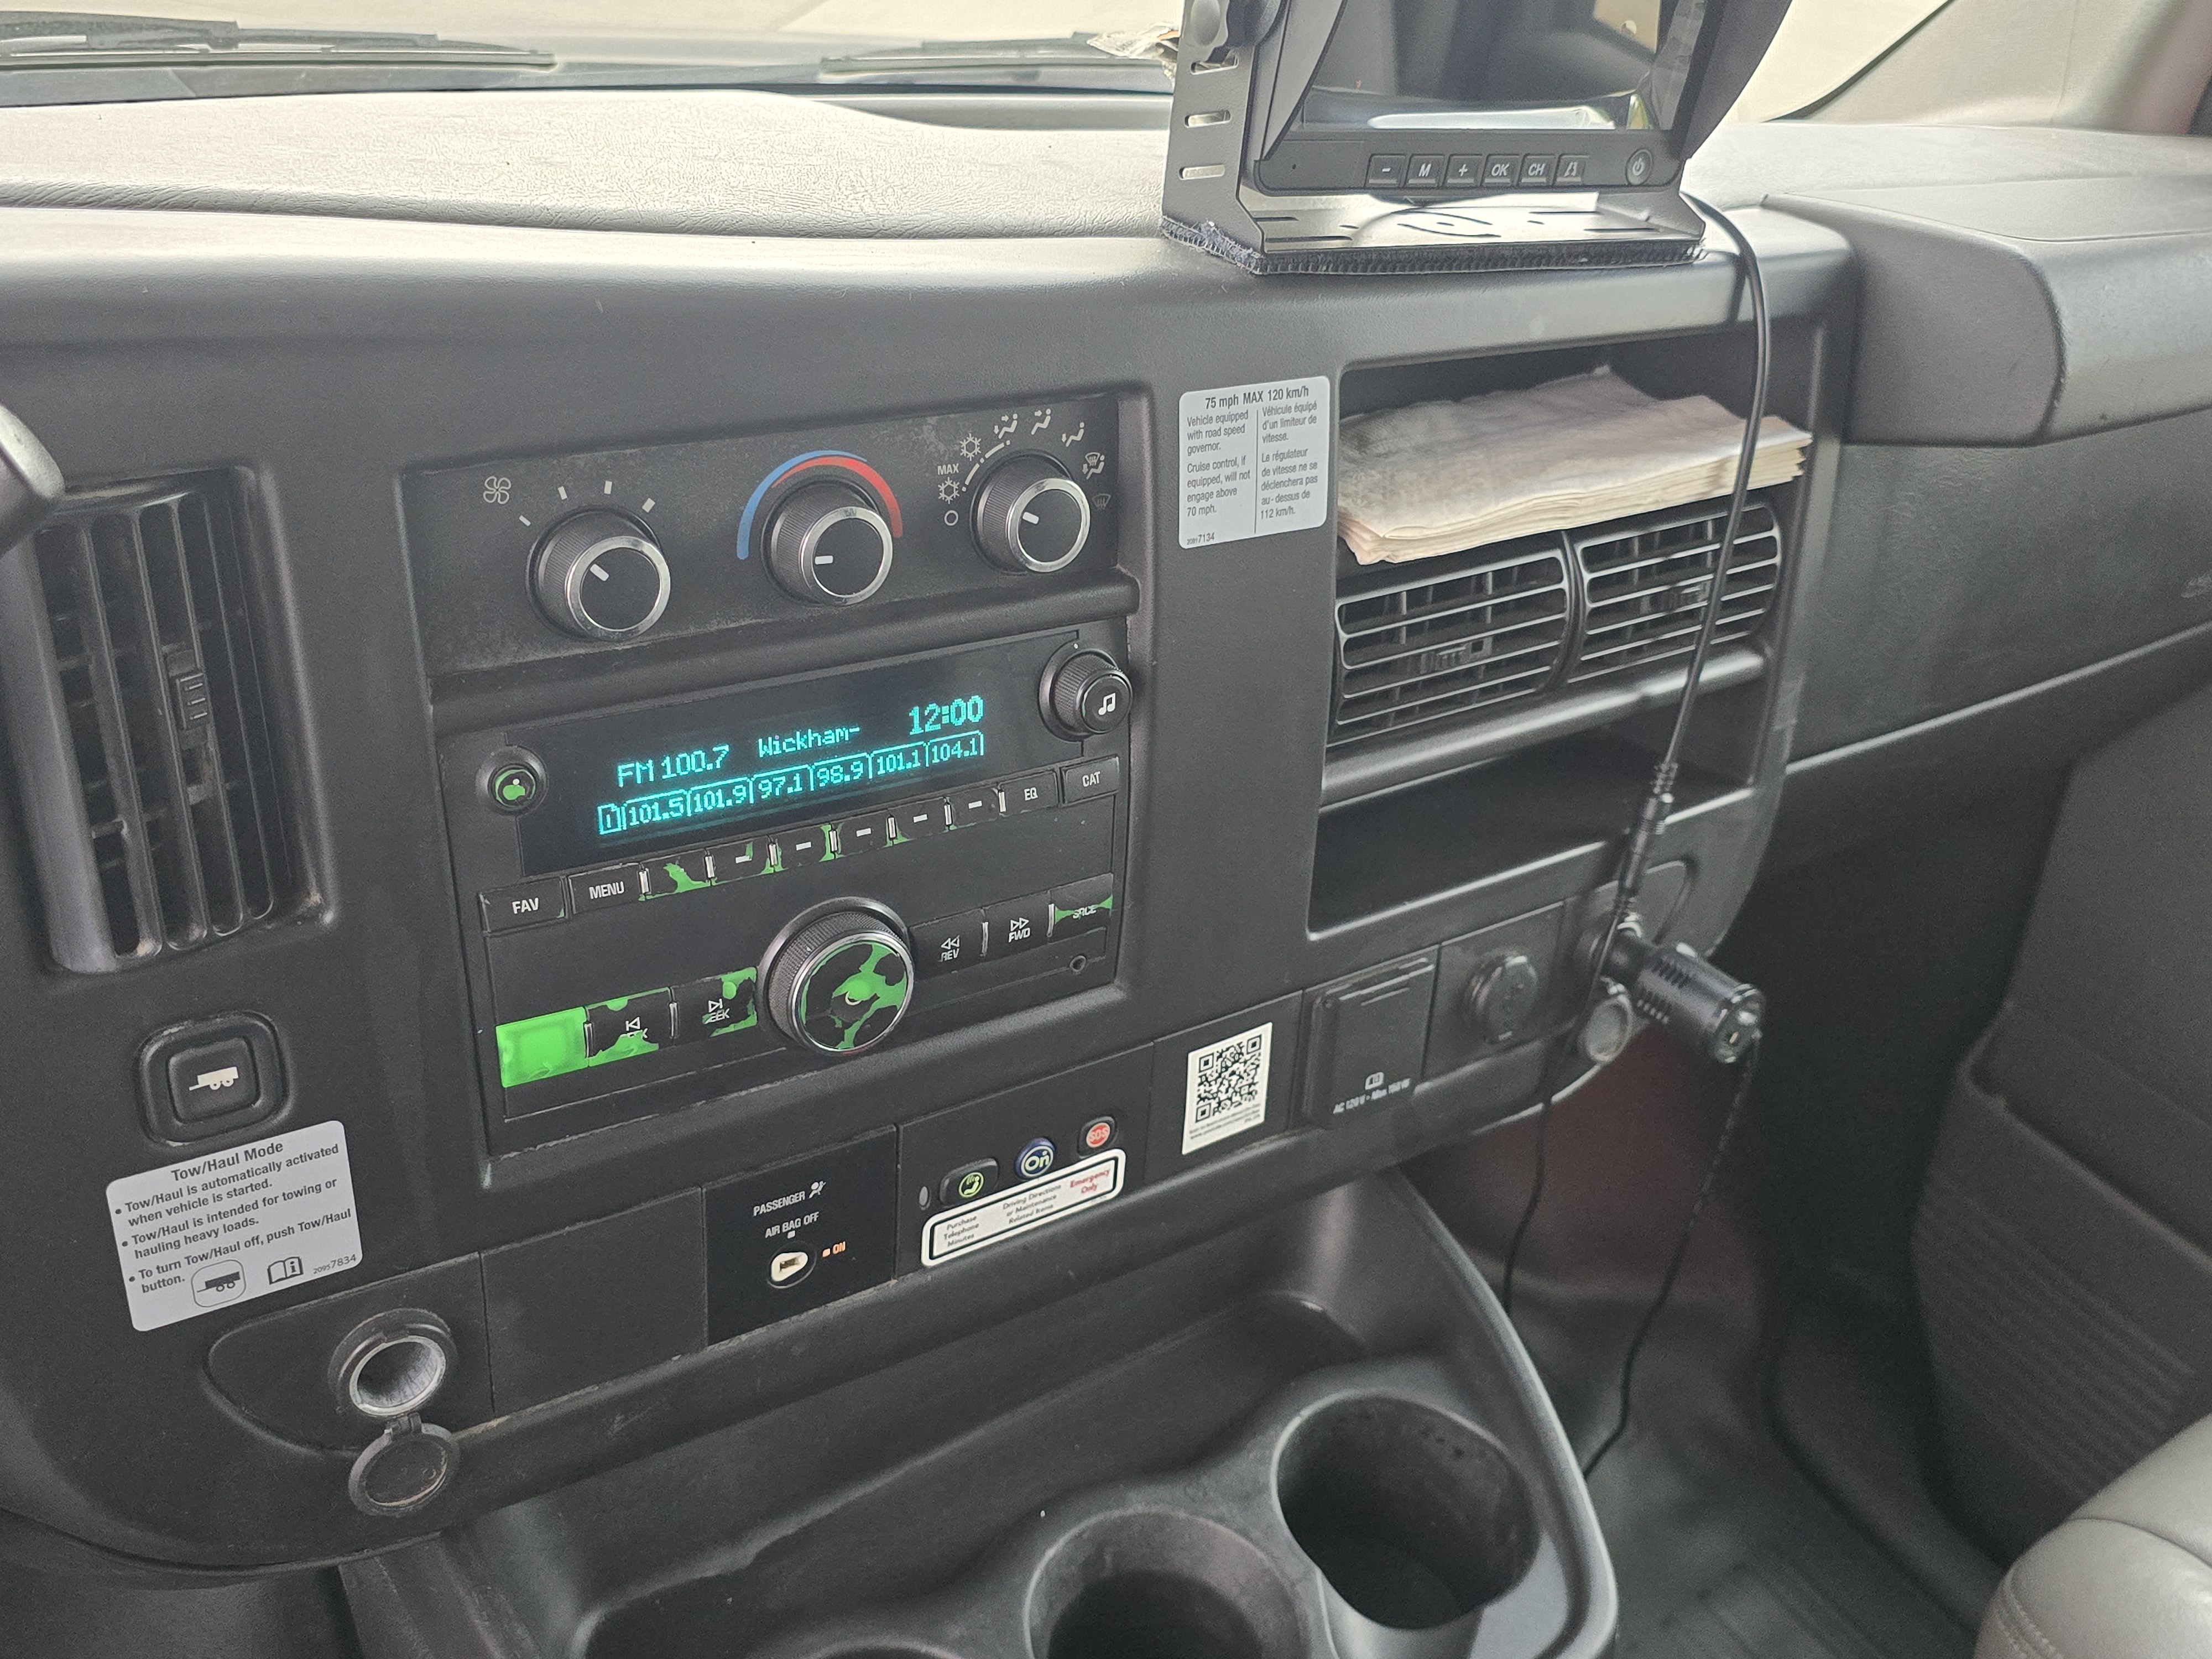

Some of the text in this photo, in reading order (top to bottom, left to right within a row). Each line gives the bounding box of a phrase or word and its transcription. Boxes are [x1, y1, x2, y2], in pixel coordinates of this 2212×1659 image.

[1419, 164, 1431, 176] M
[1491, 164, 1509, 176] OK
[1528, 164, 1545, 175] CH
[1205, 385, 1309, 410] 75 mph MAX 120 km/h
[1187, 409, 1249, 427] Vehicle equipped
[1262, 404, 1292, 417] Véhicule
[1280, 416, 1307, 428] limiteur
[1307, 414, 1317, 425] de
[1187, 423, 1245, 441] with road speed
[1262, 432, 1289, 444] vitesse.
[1187, 442, 1221, 457] governor.
[1261, 448, 1308, 463] Le régulateur
[937, 463, 959, 475] MAX
[1187, 461, 1211, 473] Cruise
[1212, 457, 1239, 470] control,
[1261, 462, 1318, 477] de vitesse ne se
[1187, 469, 1250, 489] equipped, will not
[1261, 475, 1318, 492] déclenchera pas
[1187, 487, 1237, 503] engage above
[1275, 492, 1300, 503] dessus
[1301, 489, 1311, 499] de
[1187, 504, 1217, 517] 70 mph.
[1261, 505, 1296, 520] 112 km/h.
[617, 759, 654, 788] FM
[661, 744, 729, 779] 100.7
[909, 695, 984, 736] 12:00
[629, 796, 685, 826] 101.5
[693, 784, 747, 813] 101.9
[758, 772, 804, 800] 97.1
[816, 760, 864, 787] 98.9
[877, 749, 921, 775] 101.1
[932, 738, 978, 764] 104.1
[1082, 771, 1101, 787] CAT
[1024, 787, 1039, 801] EQ
[589, 881, 625, 900] MENU
[512, 898, 540, 914] FAV
[1008, 927, 1031, 943] FWD
[940, 948, 960, 962] REV
[1089, 1126, 1108, 1142] SOS
[171, 1141, 284, 1182] Tow/Haul Mode
[1025, 1151, 1050, 1171] On
[125, 1144, 339, 1213] Tow/Haul is automatically activated
[1070, 1168, 1110, 1188] Emergency
[1081, 1182, 1097, 1194] Only
[128, 1178, 273, 1227] when vehicle is started.
[753, 1191, 806, 1217] PASSENGER
[132, 1178, 337, 1245] Tow/Haul is intended for towing or
[765, 1211, 820, 1239] AIR BAG OFF
[134, 1218, 259, 1260] hauling heavy loads.
[138, 1208, 352, 1279] To turn Tow/Haul off, push Tow/Haul
[832, 1241, 846, 1255] ON
[313, 1254, 356, 1275] 20957834
[142, 1276, 185, 1293] button.
